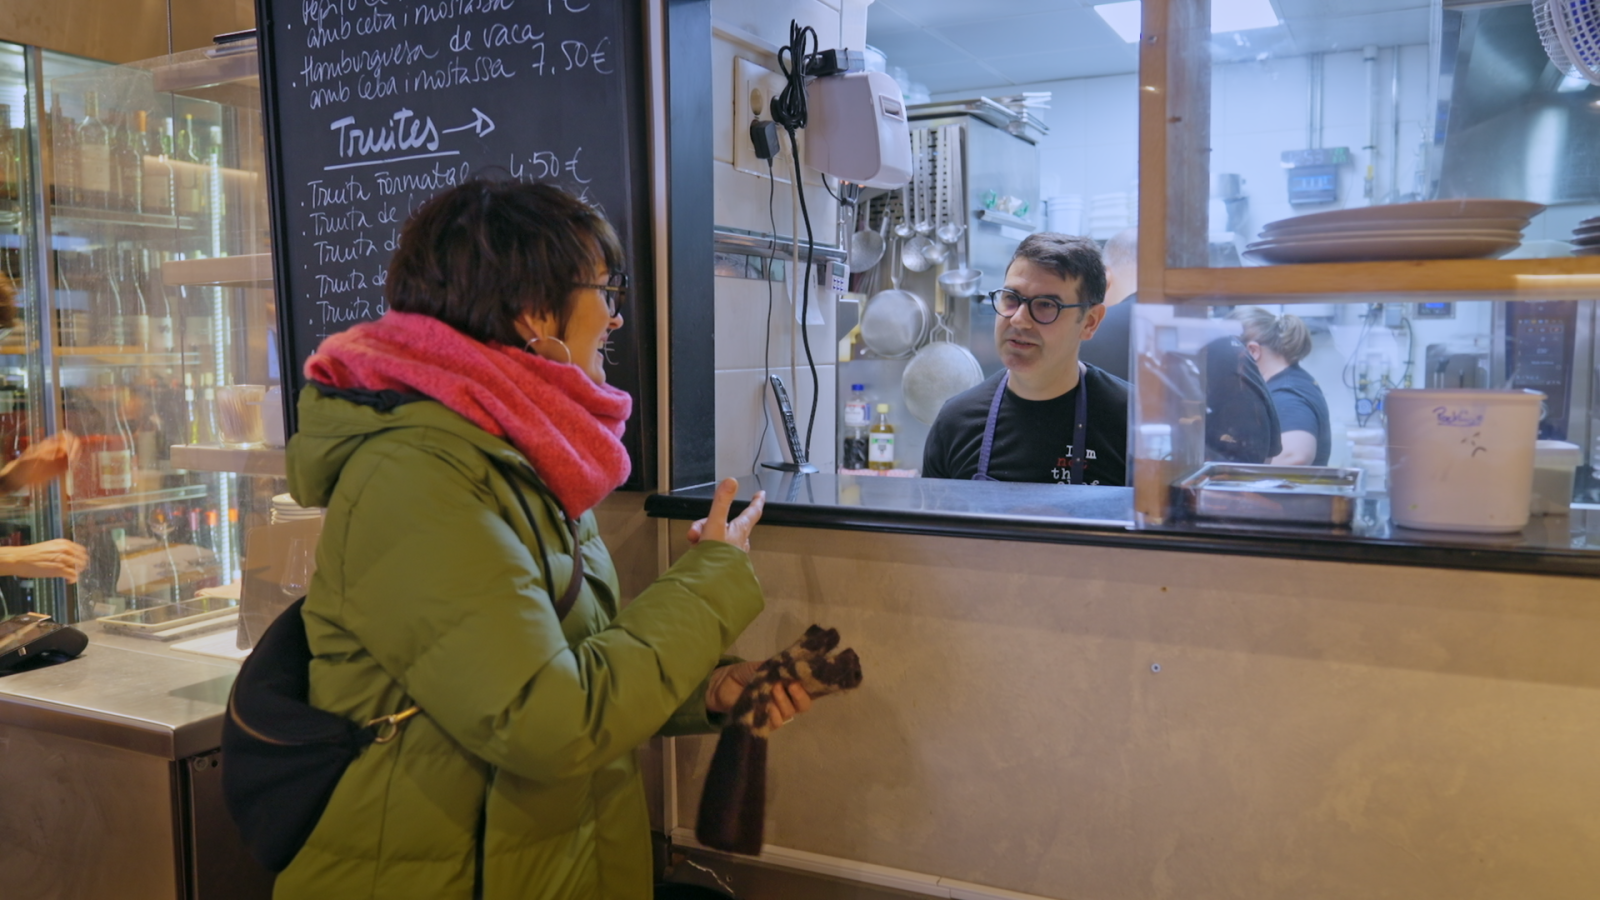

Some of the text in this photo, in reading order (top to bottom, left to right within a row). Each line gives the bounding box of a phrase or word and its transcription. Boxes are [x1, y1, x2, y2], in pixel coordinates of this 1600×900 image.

[307, 16, 351, 48] amb
[403, 4, 408, 27] i
[300, 23, 544, 87] Hamburguesa de vaca
[310, 80, 350, 110] amb
[405, 72, 409, 93] i
[414, 56, 516, 92] mostassa
[330, 107, 439, 158] Truites
[307, 175, 371, 209] Truita
[309, 206, 373, 236] Truita
[378, 201, 400, 224] de
[313, 231, 378, 266] Truita
[315, 268, 368, 298] Truita
[316, 296, 373, 325] Truita
